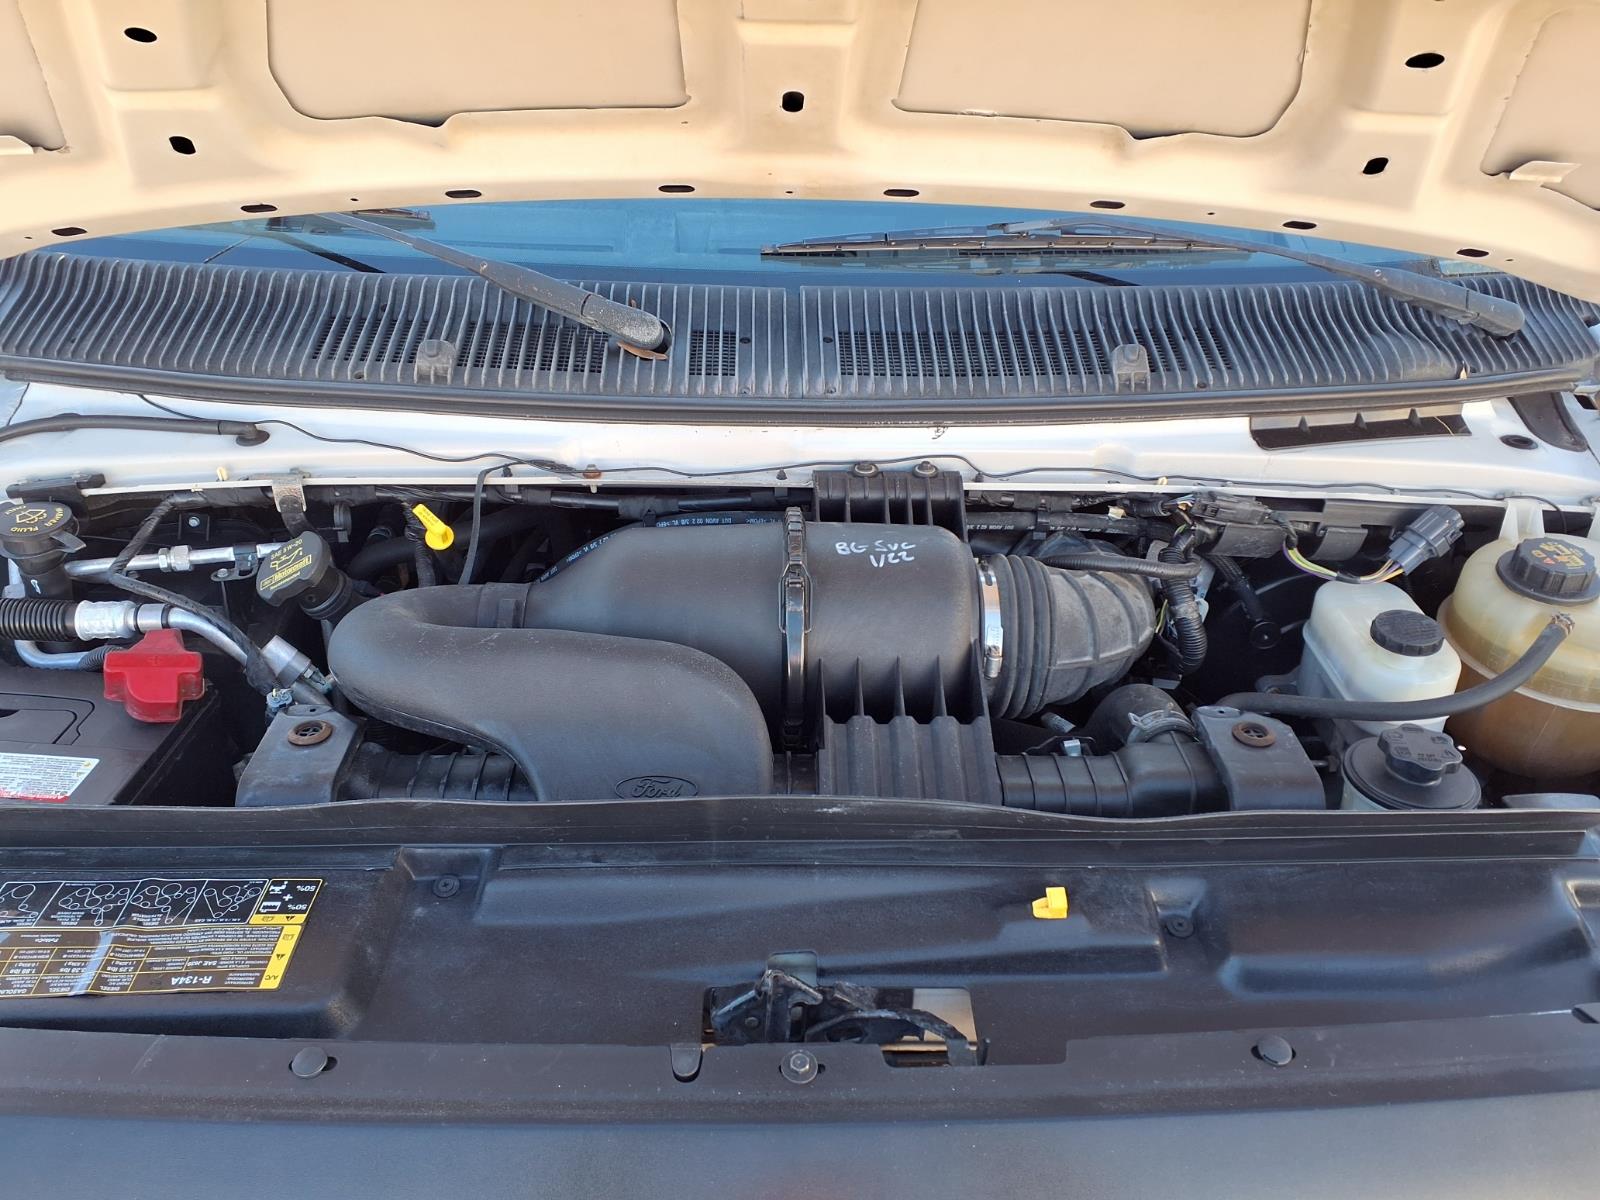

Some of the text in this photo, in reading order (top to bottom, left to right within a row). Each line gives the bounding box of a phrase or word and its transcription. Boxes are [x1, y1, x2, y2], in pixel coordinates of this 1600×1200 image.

[271, 550, 282, 560] SAE
[274, 558, 309, 582] Motorcraft
[632, 778, 683, 798] Ford
[287, 903, 308, 911] 50%
[170, 975, 212, 985] R-134A
